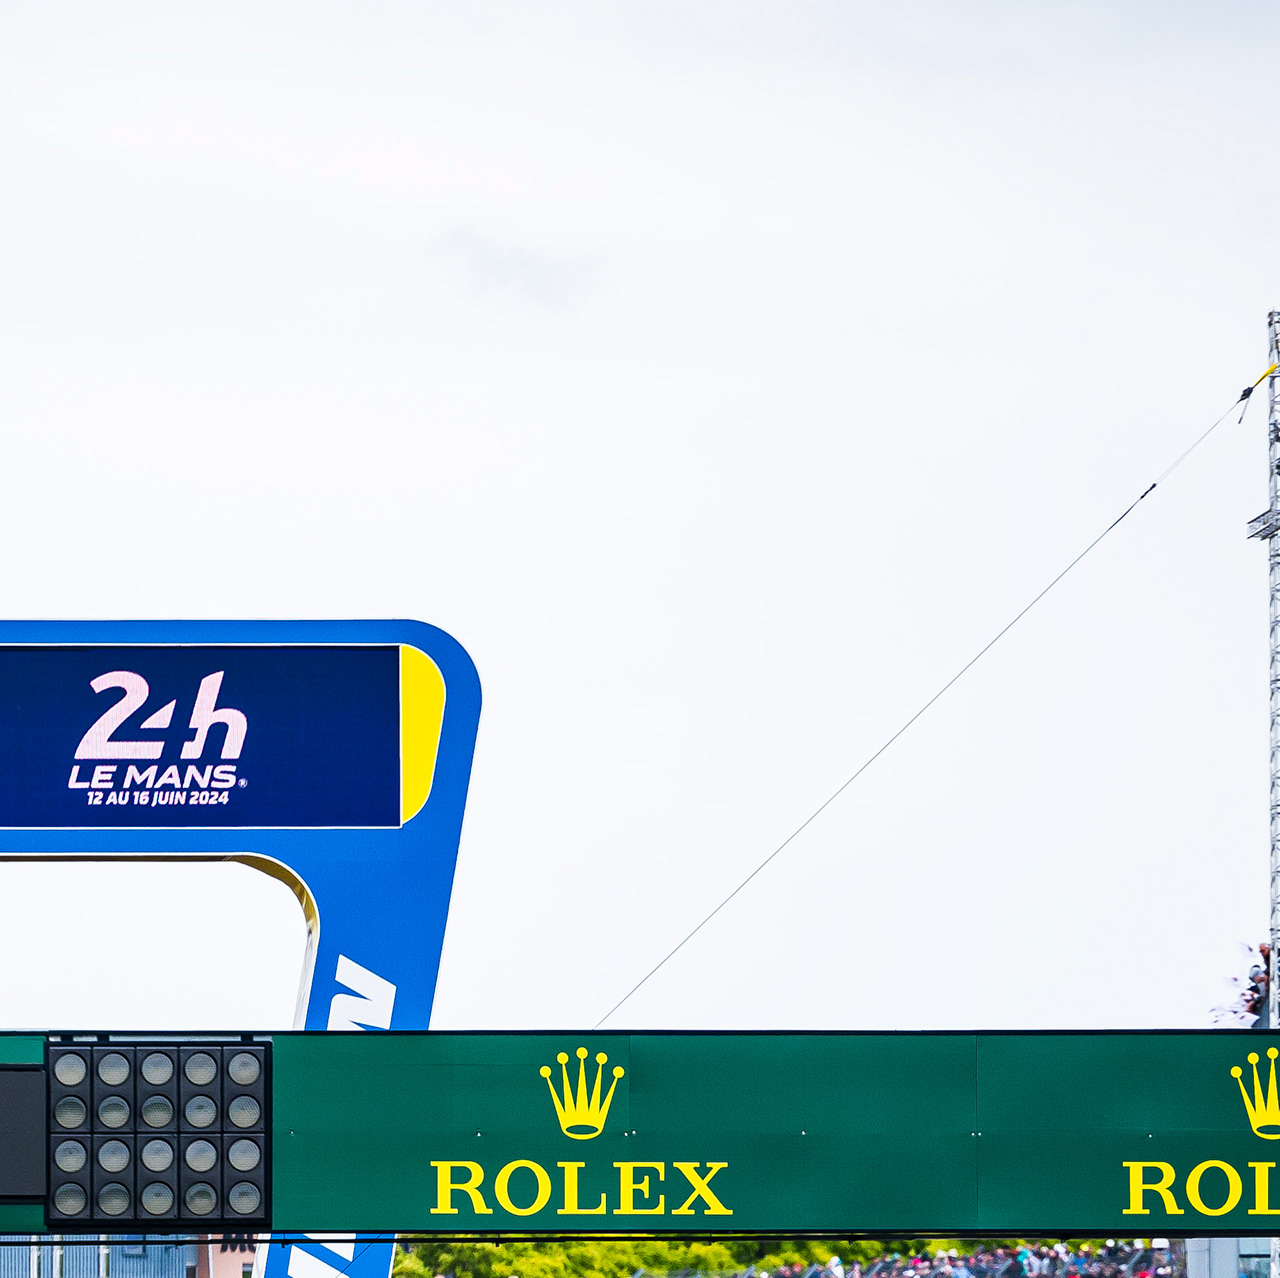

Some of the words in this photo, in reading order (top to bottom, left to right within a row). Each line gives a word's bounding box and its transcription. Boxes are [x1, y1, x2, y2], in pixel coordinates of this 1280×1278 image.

[68, 765, 117, 789] LE
[87, 791, 103, 805] 12
[105, 791, 130, 805] AU
[133, 791, 150, 805] 16
[151, 791, 186, 807] JUIN
[188, 791, 229, 805] 2024
[431, 1159, 733, 1216] ROLEX
